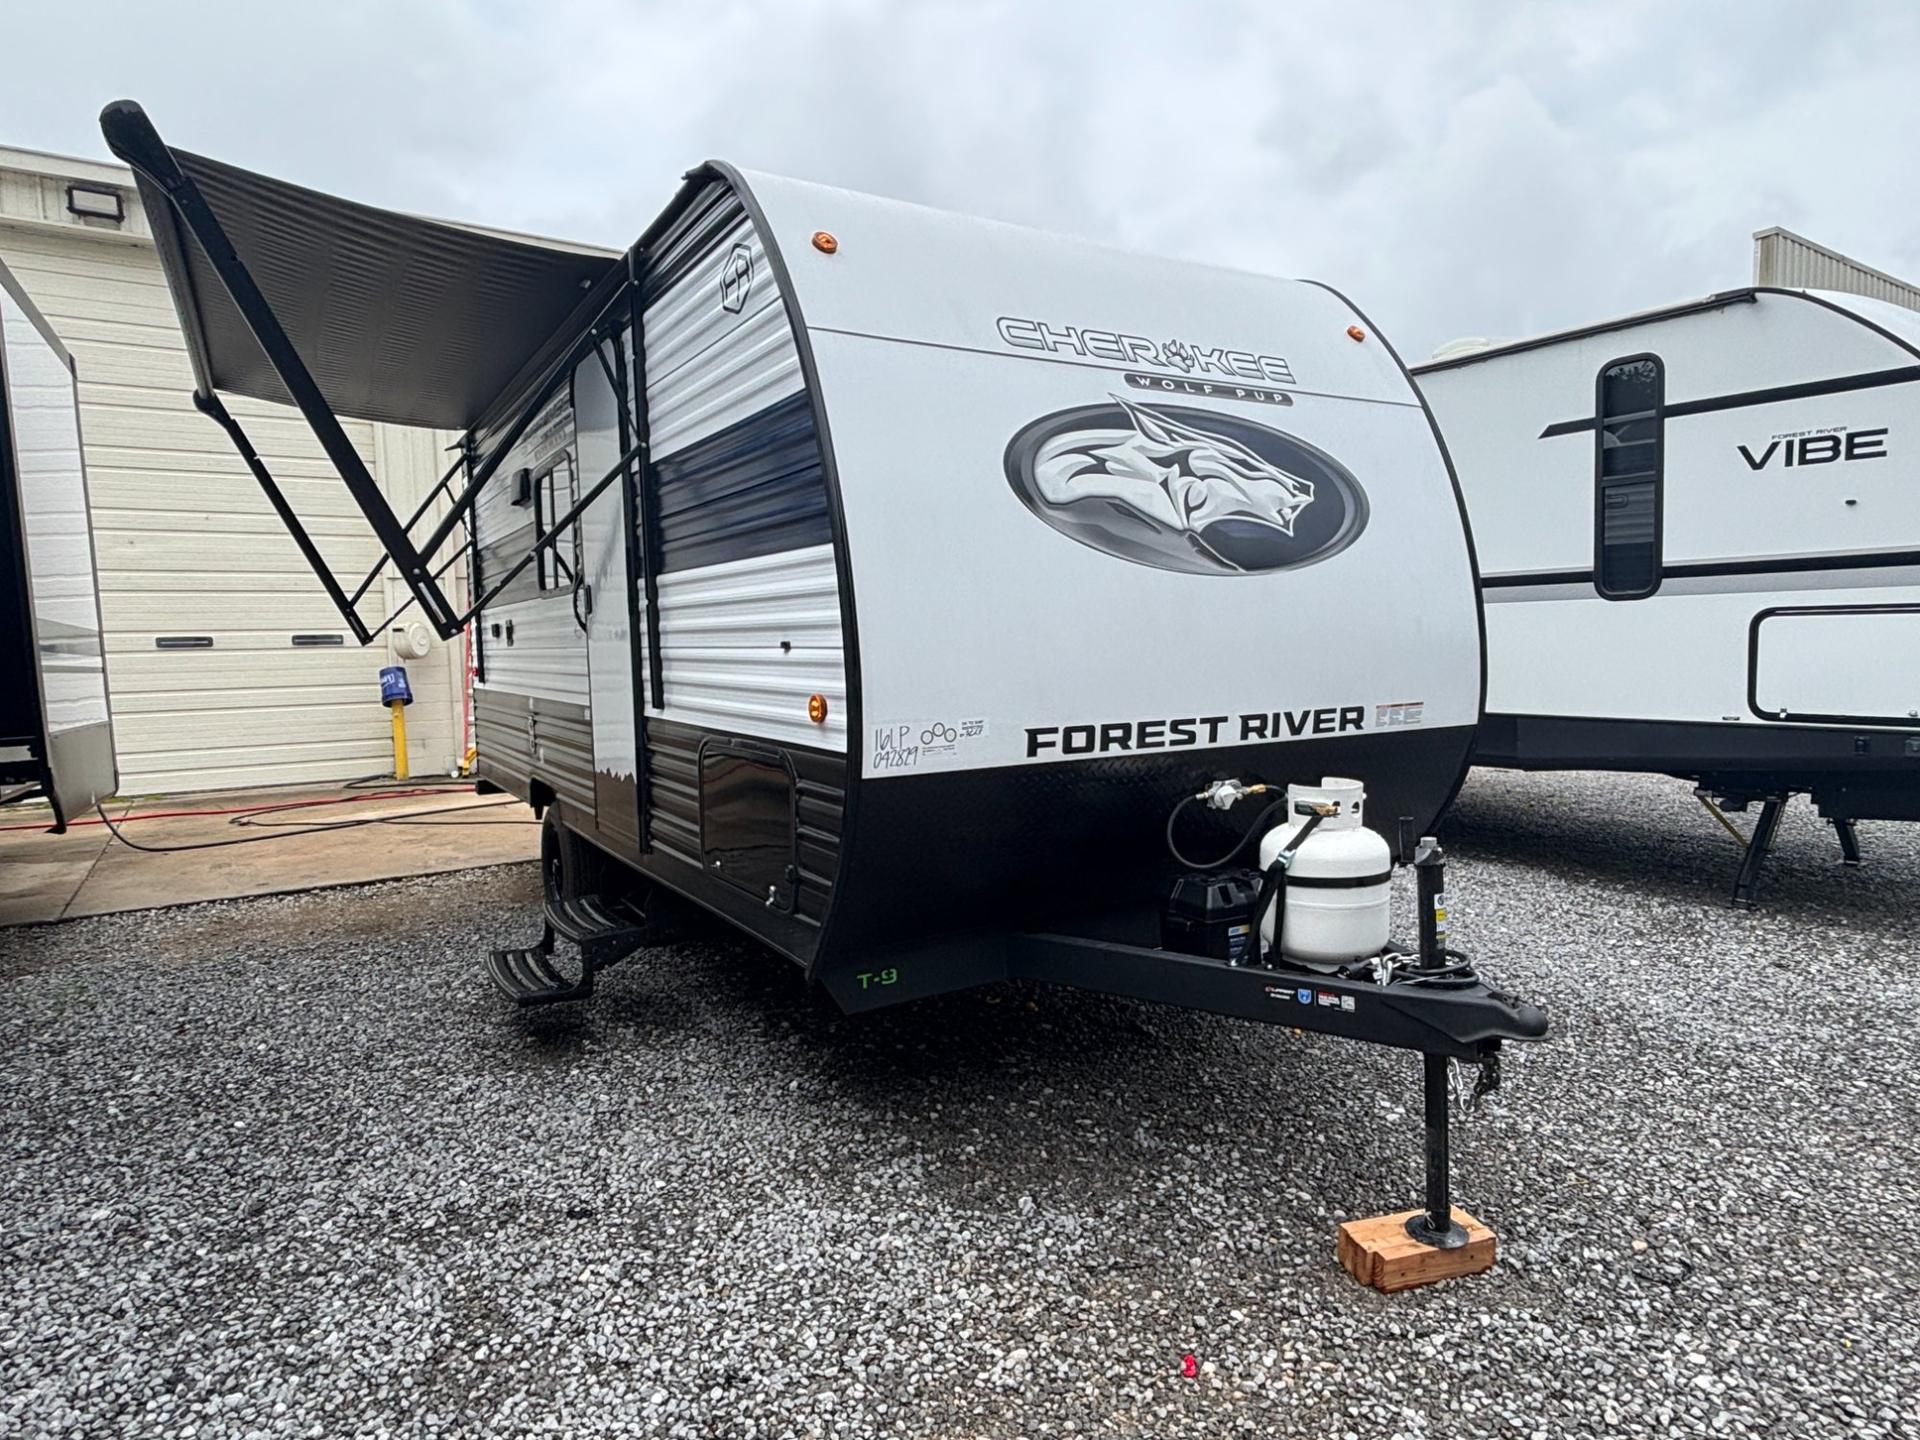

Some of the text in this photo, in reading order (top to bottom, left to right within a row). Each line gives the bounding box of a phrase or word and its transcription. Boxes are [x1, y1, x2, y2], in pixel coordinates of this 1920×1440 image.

[996, 316, 1297, 384] CHEROKEE
[1135, 376, 1283, 403] WOLF PUP
[1736, 427, 1889, 471] VIBE
[1771, 426, 1848, 440] FOREST RIVER
[1024, 715, 1229, 758] FOREST
[1239, 705, 1365, 741] RIVER
